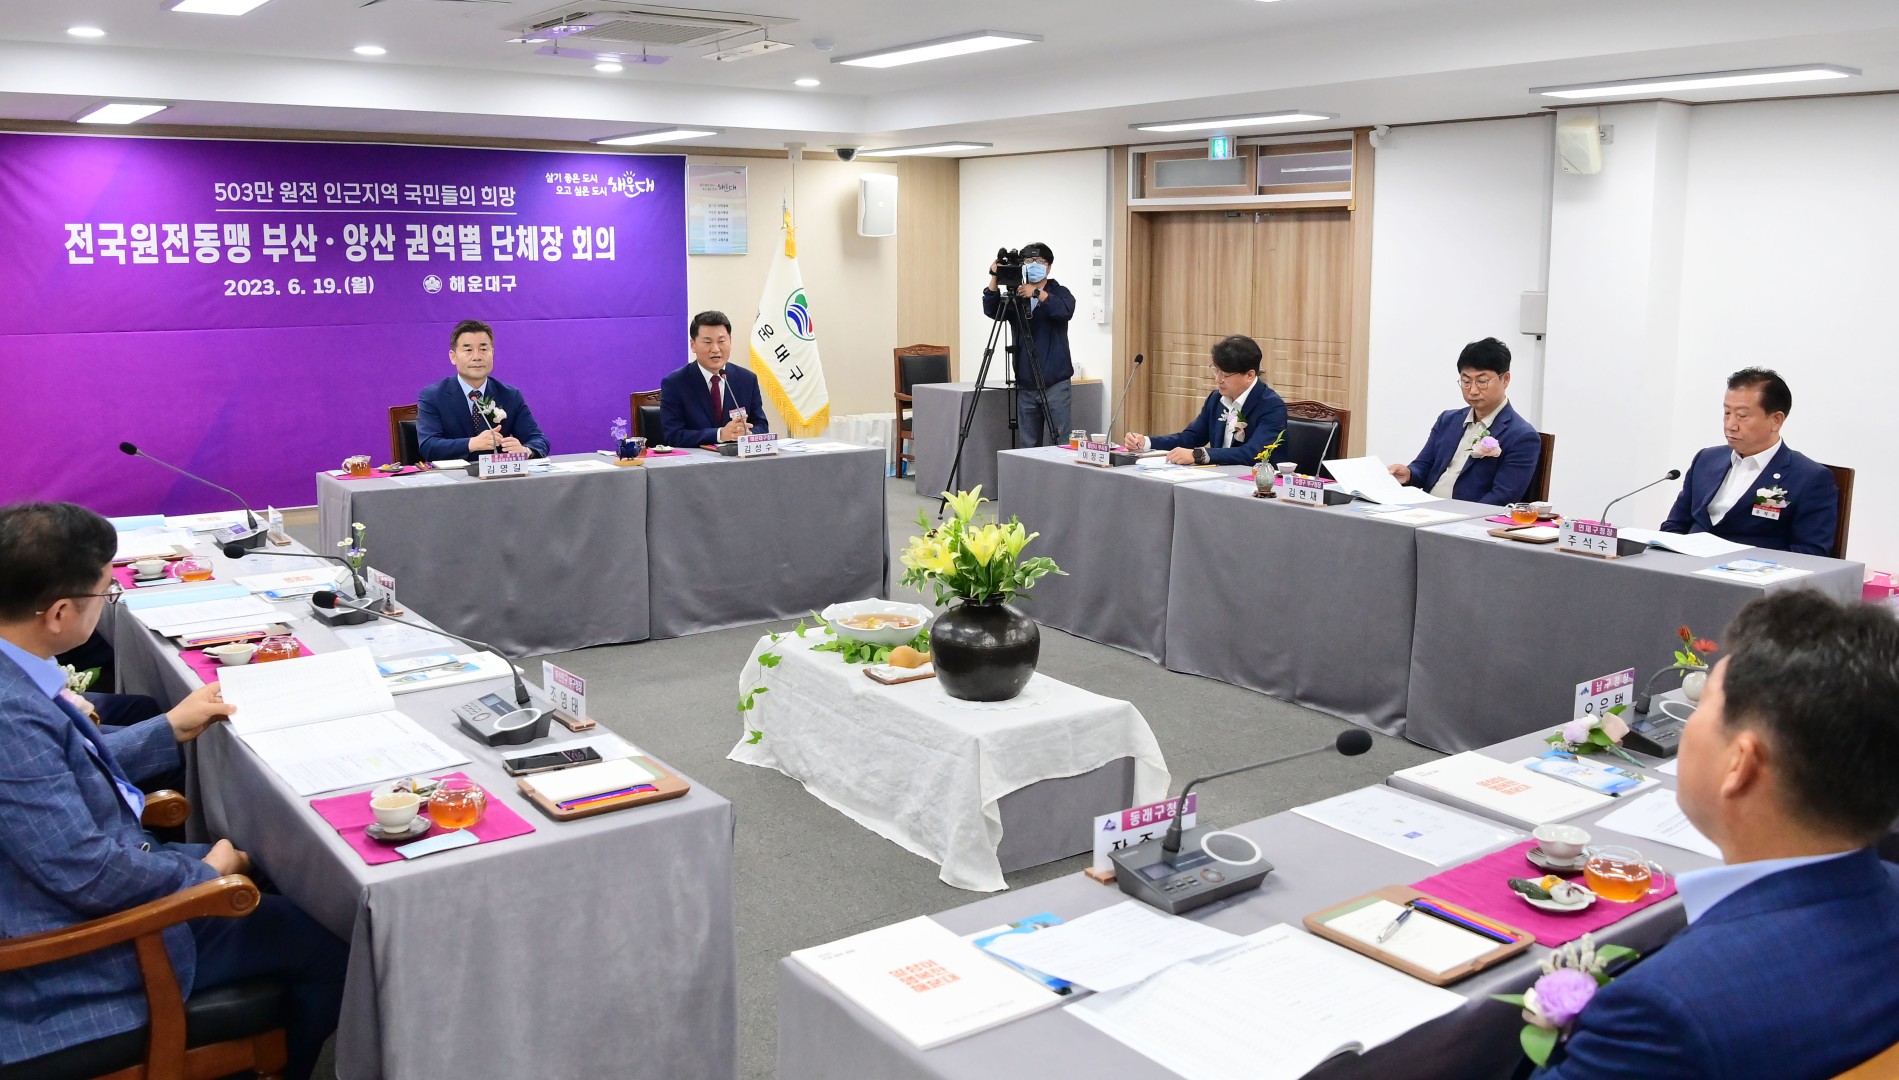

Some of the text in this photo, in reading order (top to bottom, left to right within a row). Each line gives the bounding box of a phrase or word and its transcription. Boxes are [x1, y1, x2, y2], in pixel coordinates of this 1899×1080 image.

[545, 172, 598, 184] 살기 좋은 도시
[608, 171, 655, 198] 해운대
[214, 181, 516, 208] 503만 원전 인근지역 국민들의 희망
[556, 186, 608, 197] 오고 싶은 도시
[64, 222, 252, 265] 전국원전동맹
[405, 223, 482, 262] 권역별
[491, 225, 564, 262] 단체장
[571, 225, 616, 261] 회의
[223, 278, 281, 297] 2023.
[287, 278, 306, 295] 6.
[449, 274, 517, 293] 해운대구
[1578, 524, 1613, 537] 연제구청장
